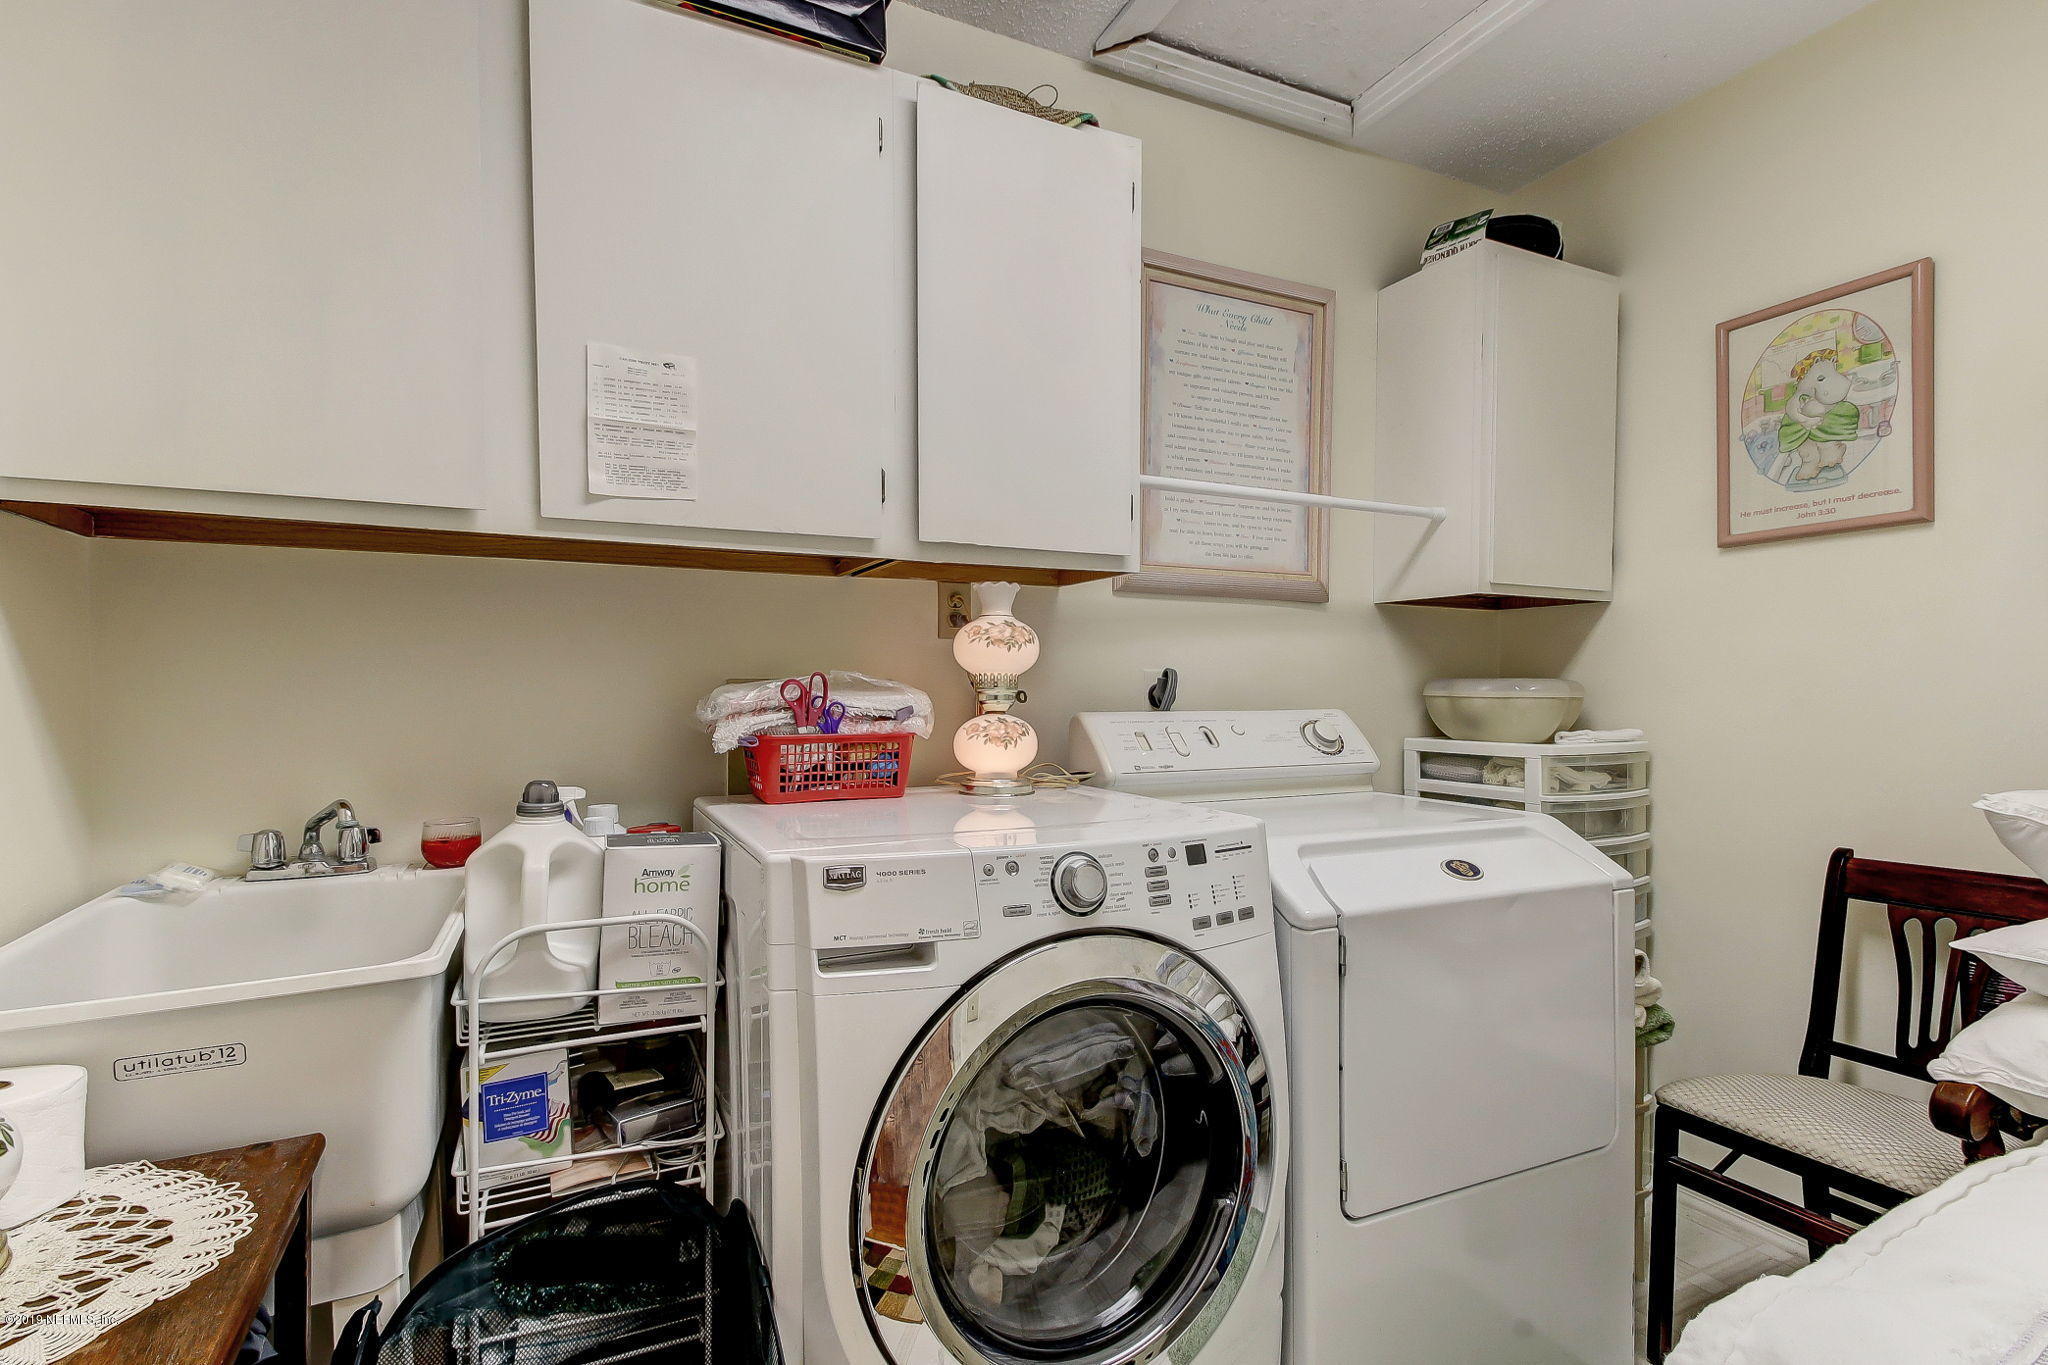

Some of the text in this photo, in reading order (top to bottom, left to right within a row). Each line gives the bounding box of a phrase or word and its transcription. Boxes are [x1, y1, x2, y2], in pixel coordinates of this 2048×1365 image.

[1197, 303, 1273, 326] What Every Child
[1219, 320, 1247, 332] Needs
[1753, 508, 1773, 516] must
[1813, 499, 1826, 507] but
[1833, 494, 1855, 503] must
[1796, 511, 1816, 519] John
[642, 868, 675, 877] Amway
[828, 870, 862, 880] MAYTAG
[634, 877, 690, 893] home
[628, 924, 693, 949] BLEACH
[219, 1046, 236, 1058] 12
[486, 1088, 543, 1106] Tri-Zyme
